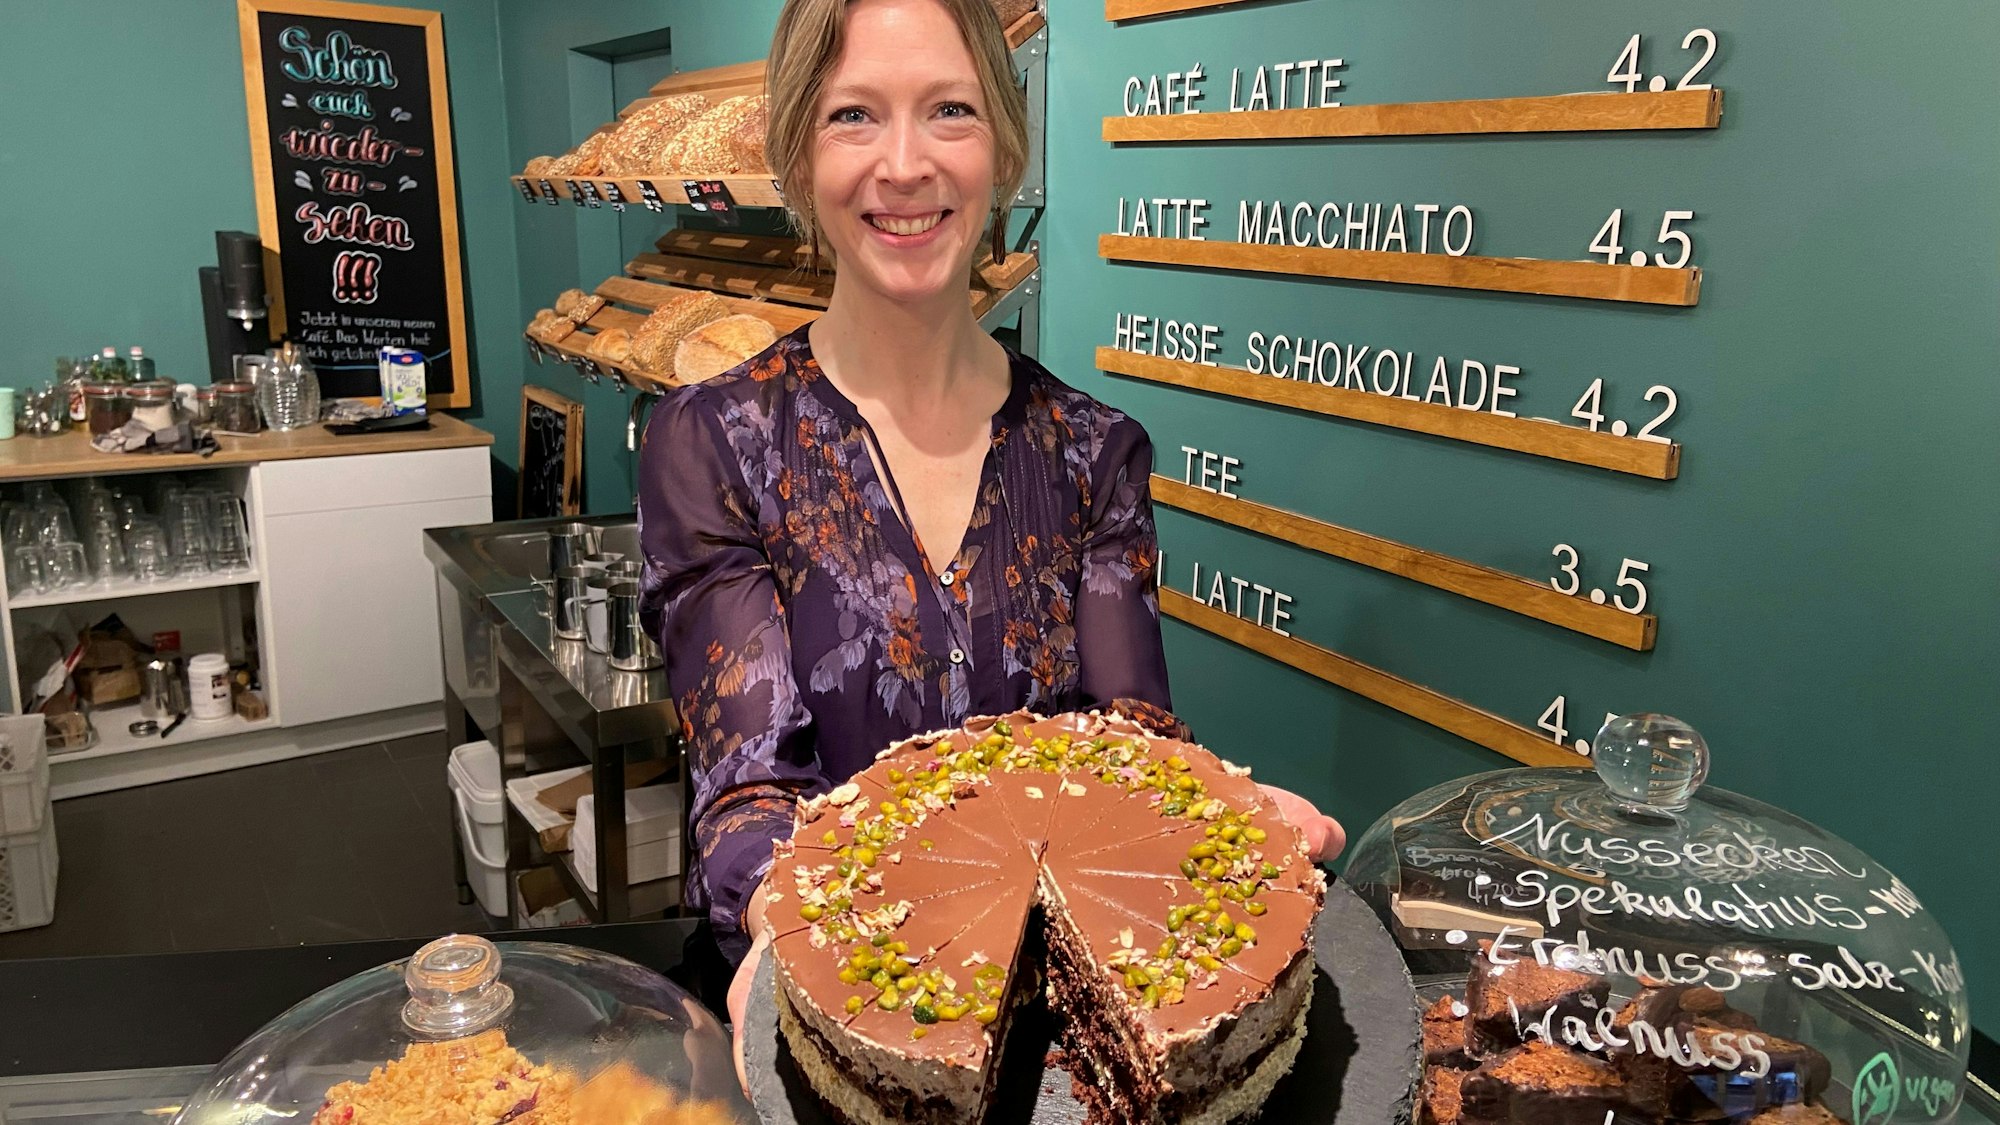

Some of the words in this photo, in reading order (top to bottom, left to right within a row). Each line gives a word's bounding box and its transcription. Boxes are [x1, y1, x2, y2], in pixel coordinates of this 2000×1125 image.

[279, 26, 399, 90] Schön
[1123, 62, 1202, 117] CAFÉ
[1229, 58, 1344, 112] LATTE
[1607, 28, 1718, 93] 4.2
[308, 89, 376, 121] euch
[295, 202, 415, 251] Sehen
[1114, 197, 1207, 241] LATTE
[1237, 200, 1474, 257] MACCHIATO
[1588, 208, 1694, 268] 4.5
[301, 311, 338, 326] Jetzt
[341, 314, 352, 327] in
[354, 317, 401, 328] unserem
[403, 320, 436, 329] neuen
[336, 329, 358, 343] Das
[362, 328, 405, 346] Warten
[410, 332, 431, 346] hat
[1115, 312, 1220, 367] HEISSE
[1246, 331, 1521, 418] SCHOKOLADE
[1571, 378, 1678, 444] 4.2
[1181, 446, 1240, 499] TEE
[1192, 562, 1293, 638] LATTE
[1550, 543, 1651, 614] 3.5
[1537, 695, 1621, 756] 4.
[1507, 996, 1771, 1079] Walnuss
[1905, 1076, 1956, 1117] vegan
